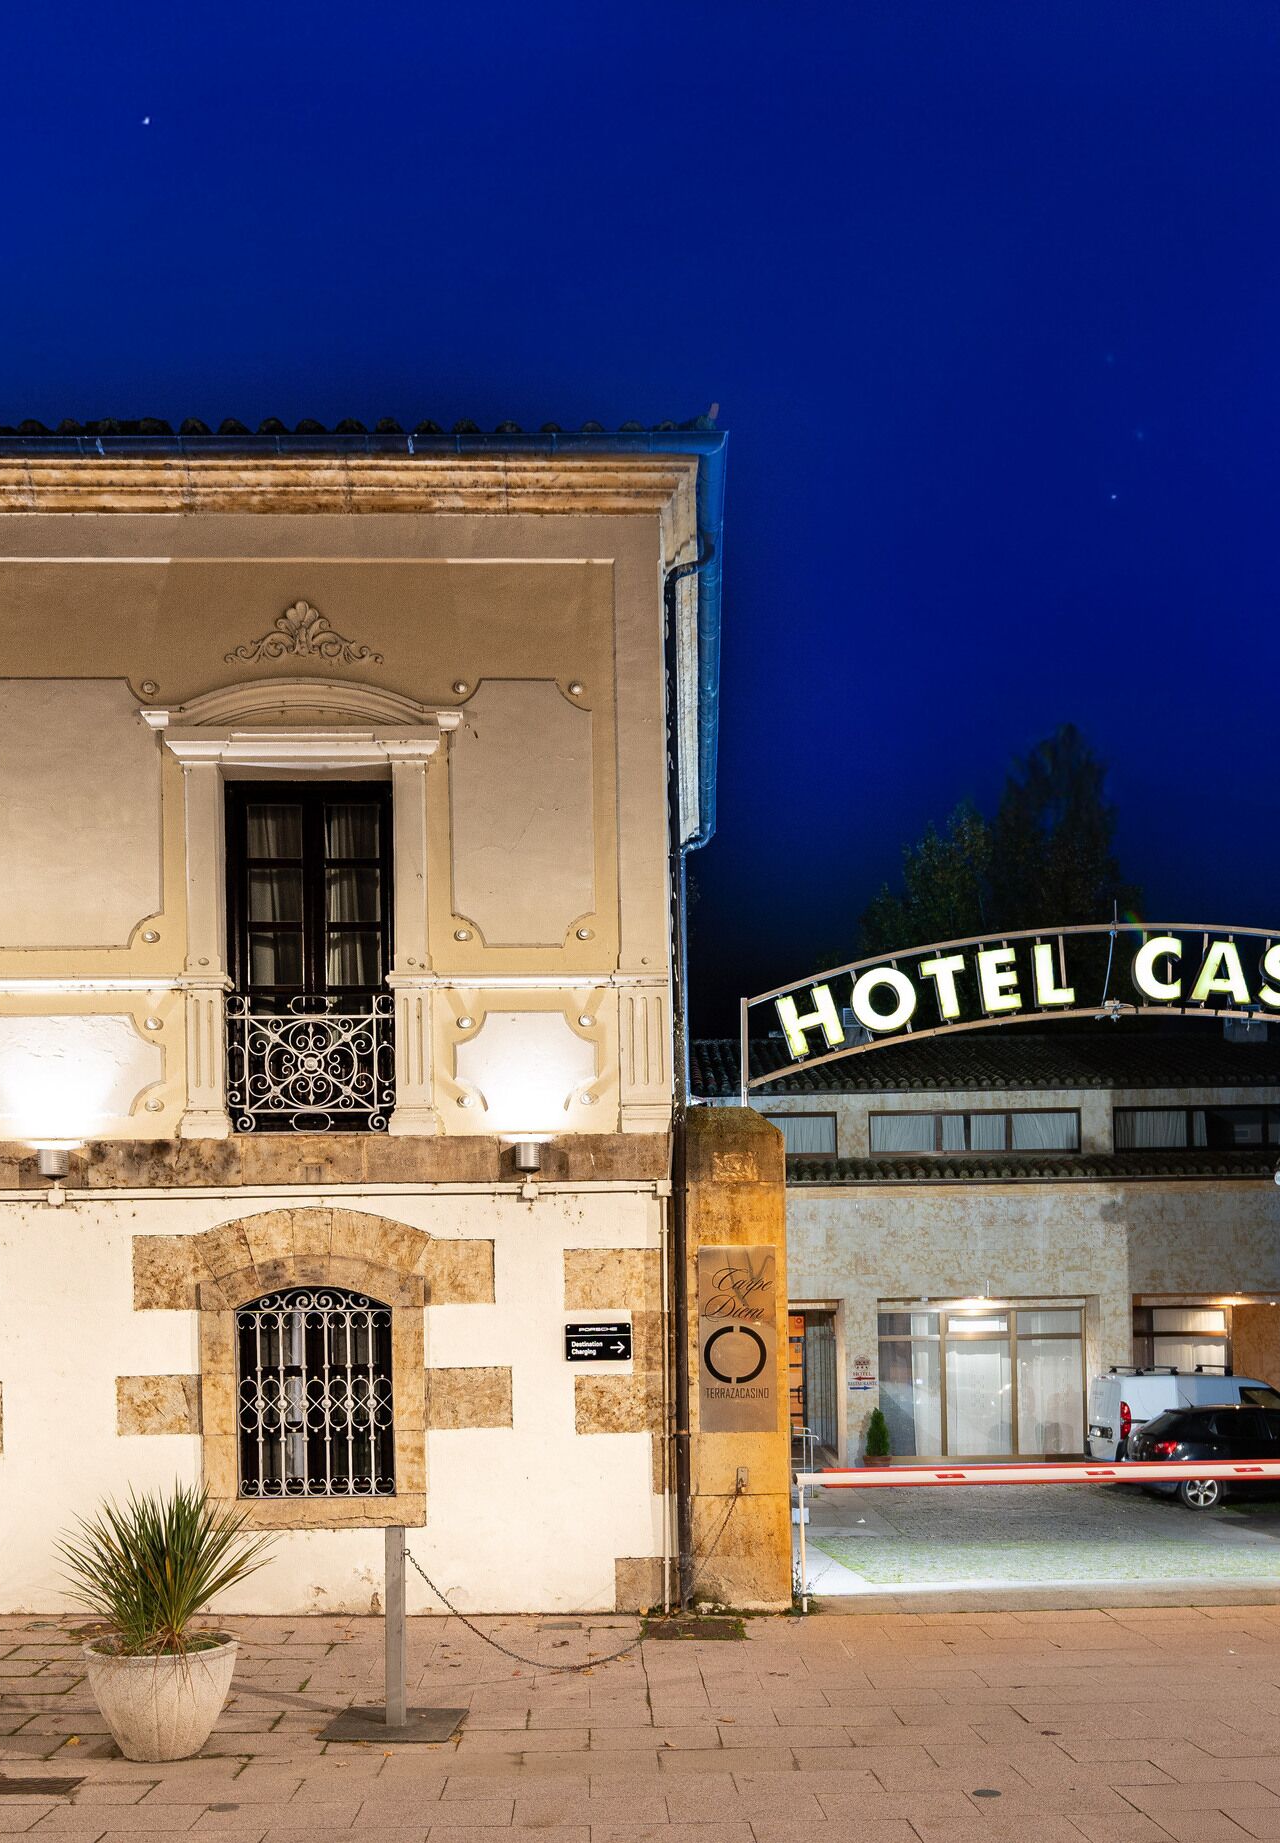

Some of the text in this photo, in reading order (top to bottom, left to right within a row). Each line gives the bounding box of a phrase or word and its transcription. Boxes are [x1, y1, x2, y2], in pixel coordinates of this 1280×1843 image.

[776, 943, 1075, 1059] HOTEL
[712, 1267, 773, 1299] Carpe
[701, 1294, 765, 1322] Diem
[571, 1348, 597, 1356] Charging
